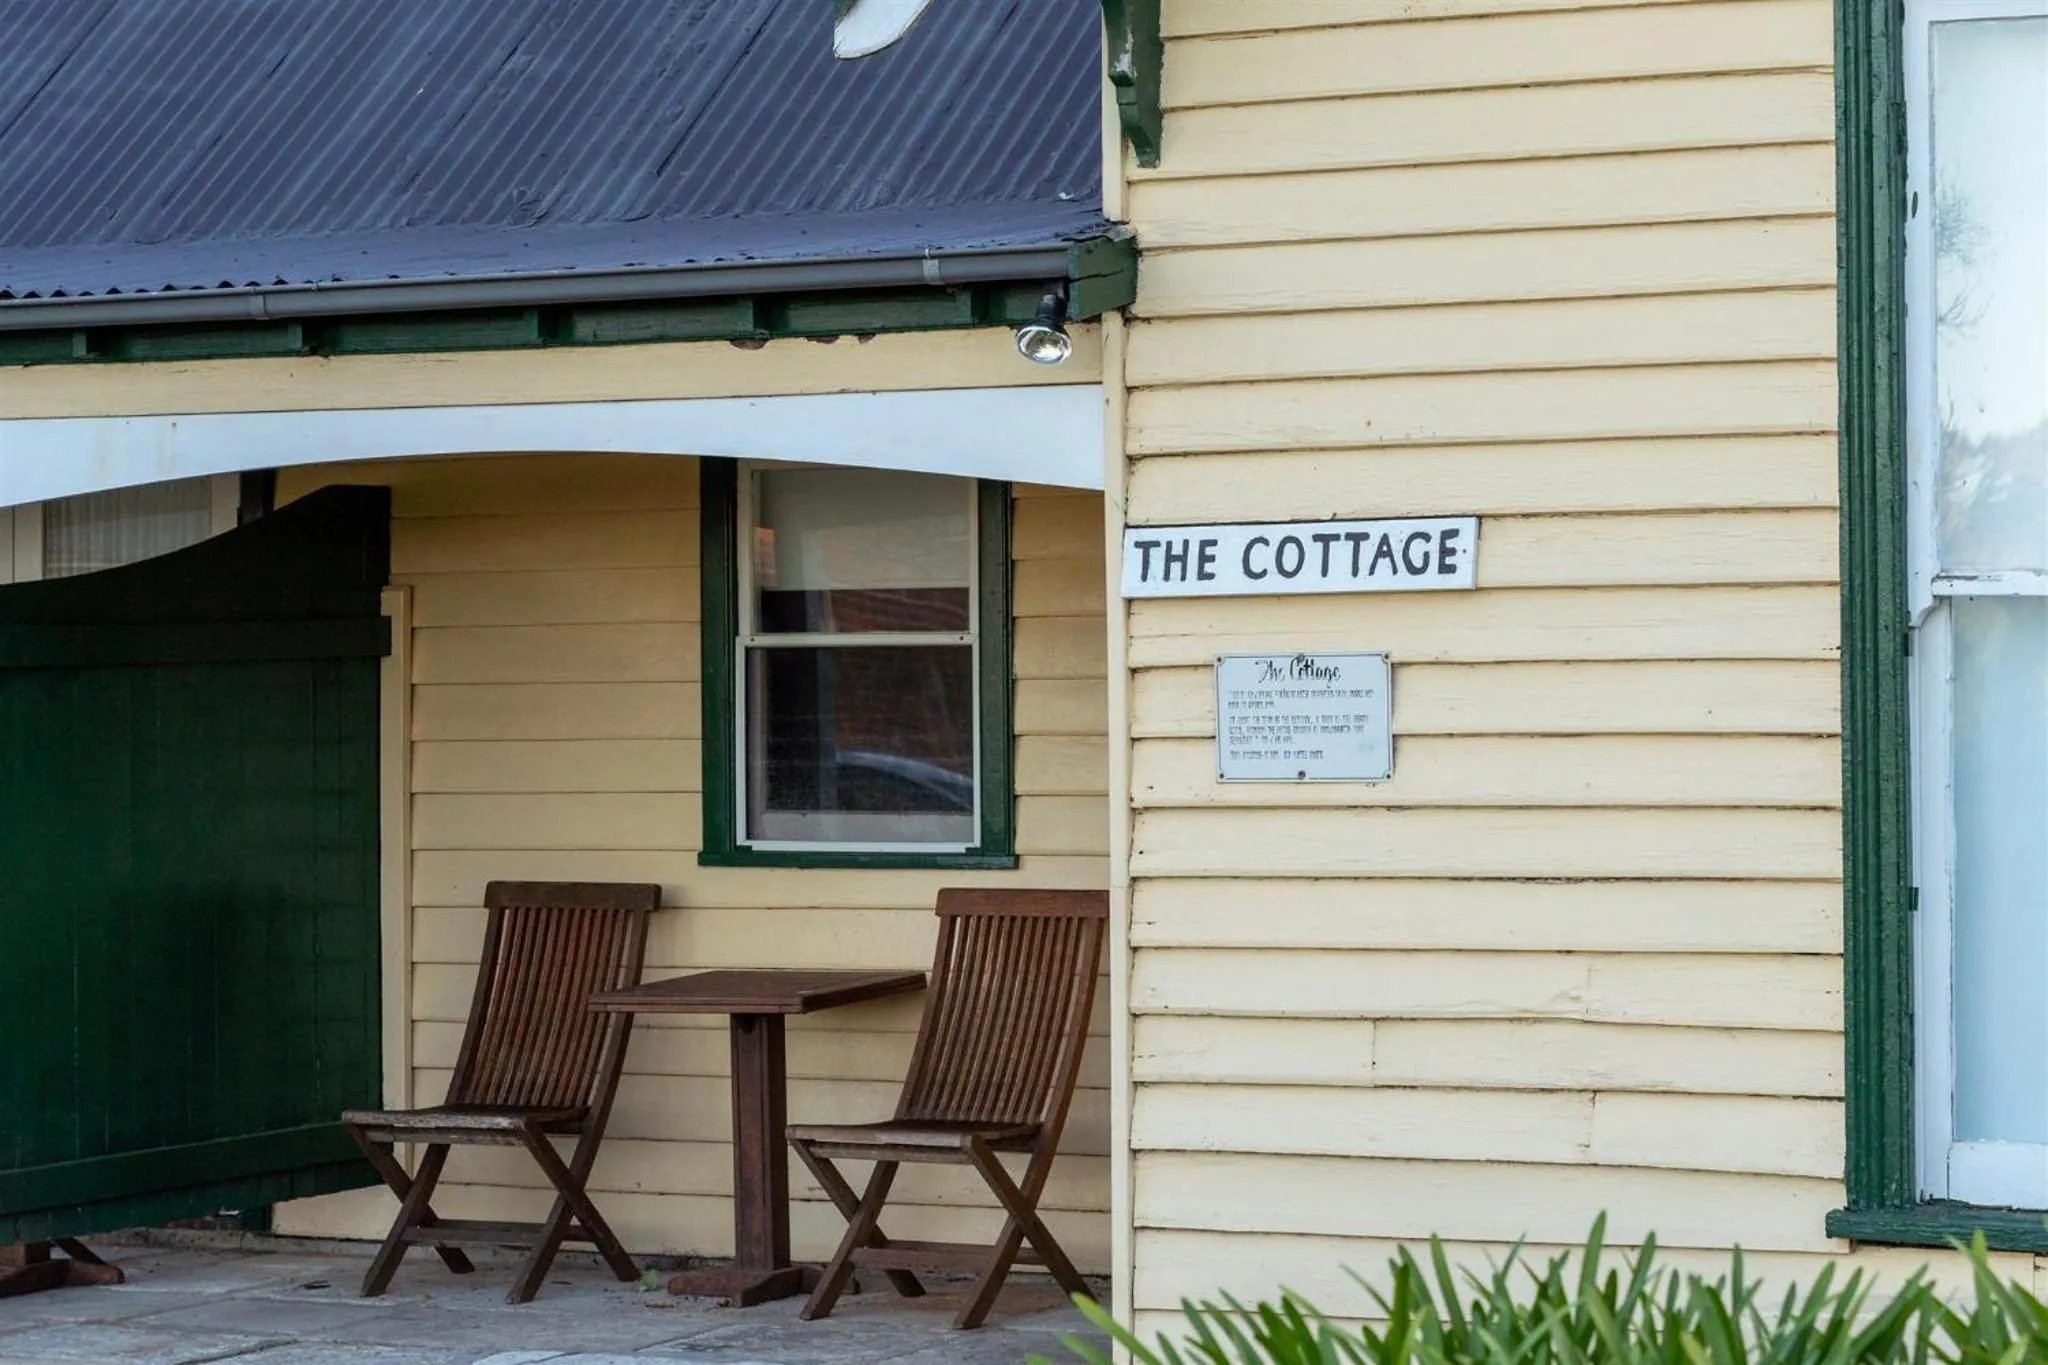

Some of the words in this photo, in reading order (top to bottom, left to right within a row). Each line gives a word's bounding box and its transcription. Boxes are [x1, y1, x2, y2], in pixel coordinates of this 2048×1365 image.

[1133, 538, 1218, 582] THE
[1241, 528, 1460, 581] COTTAGE
[1254, 659, 1285, 684] The
[1289, 655, 1341, 688] Cottage
